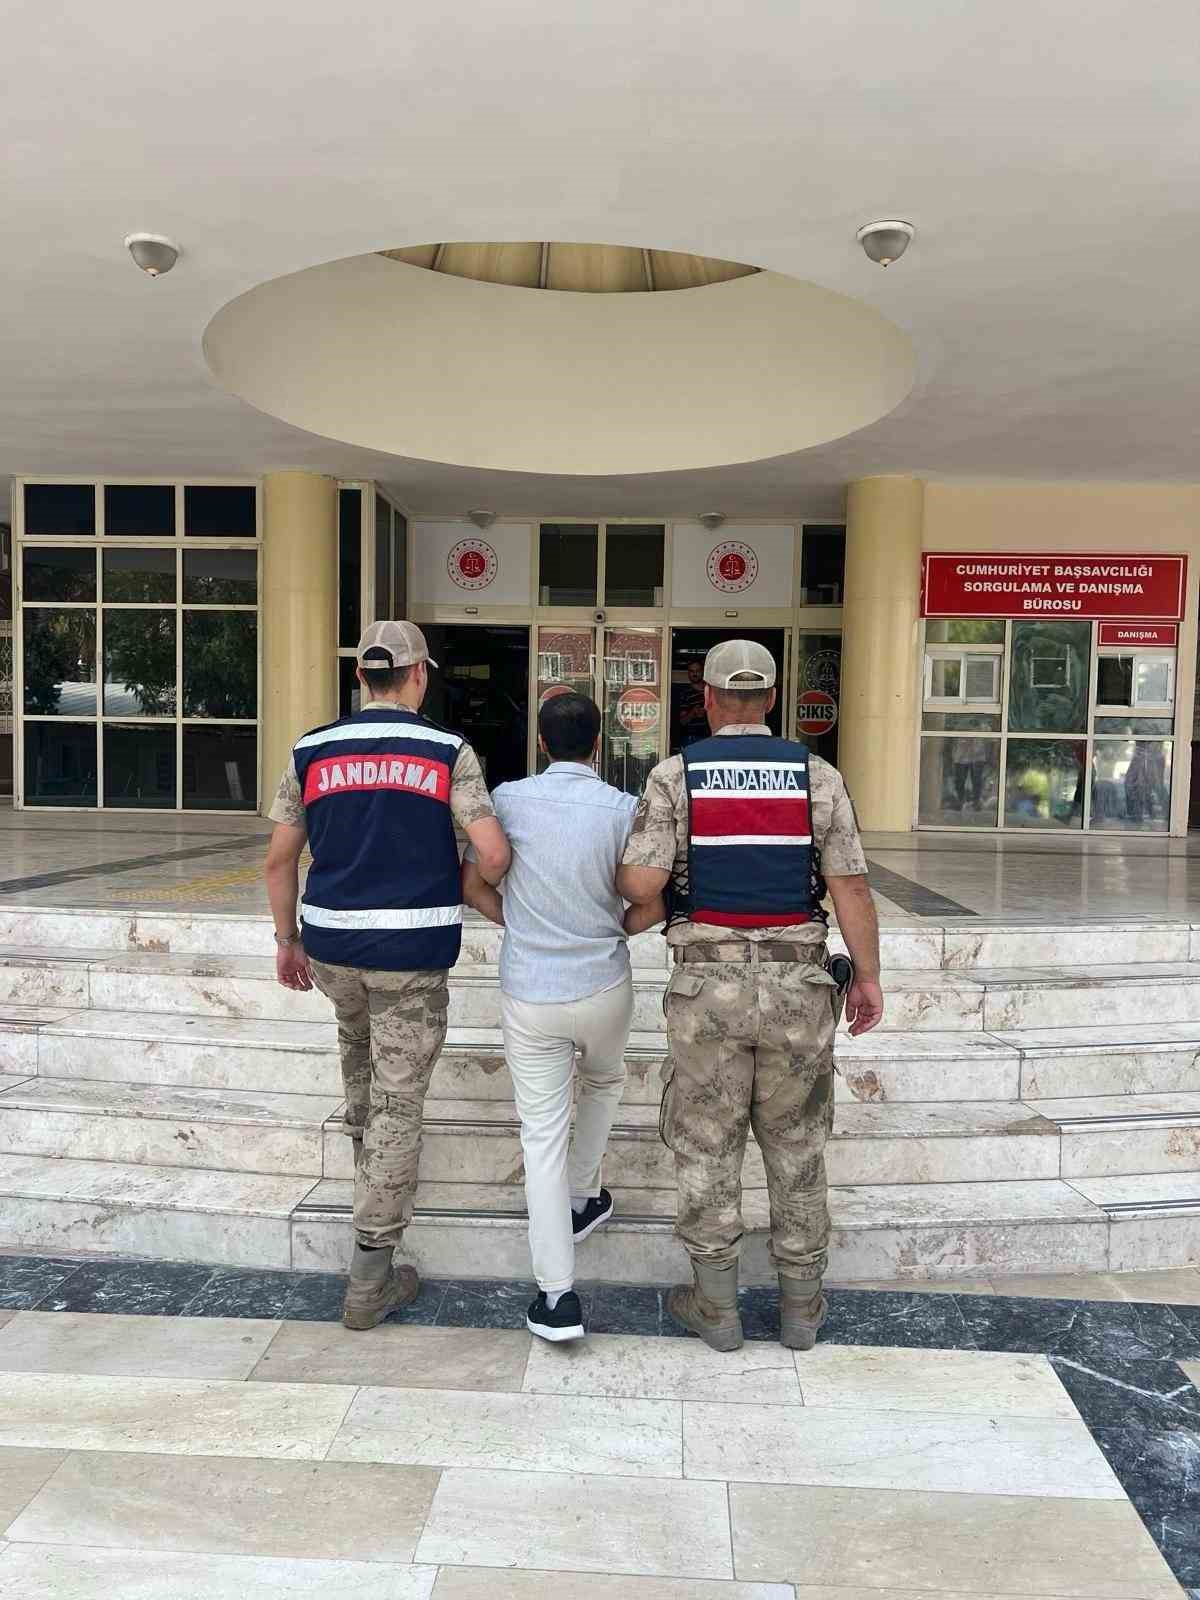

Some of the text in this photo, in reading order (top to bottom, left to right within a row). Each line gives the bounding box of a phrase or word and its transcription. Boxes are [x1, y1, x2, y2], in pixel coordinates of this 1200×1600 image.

[956, 563, 1153, 579] CUMHURİYET BAŞSAVCILIĞI
[963, 582, 1144, 595] SORGULAMA VE DANIŞMA
[1023, 598, 1082, 610] BÜROSU
[1117, 631, 1158, 640] DANIŞMA
[318, 760, 438, 794] JANDARMA
[700, 768, 799, 790] JANDARMA
